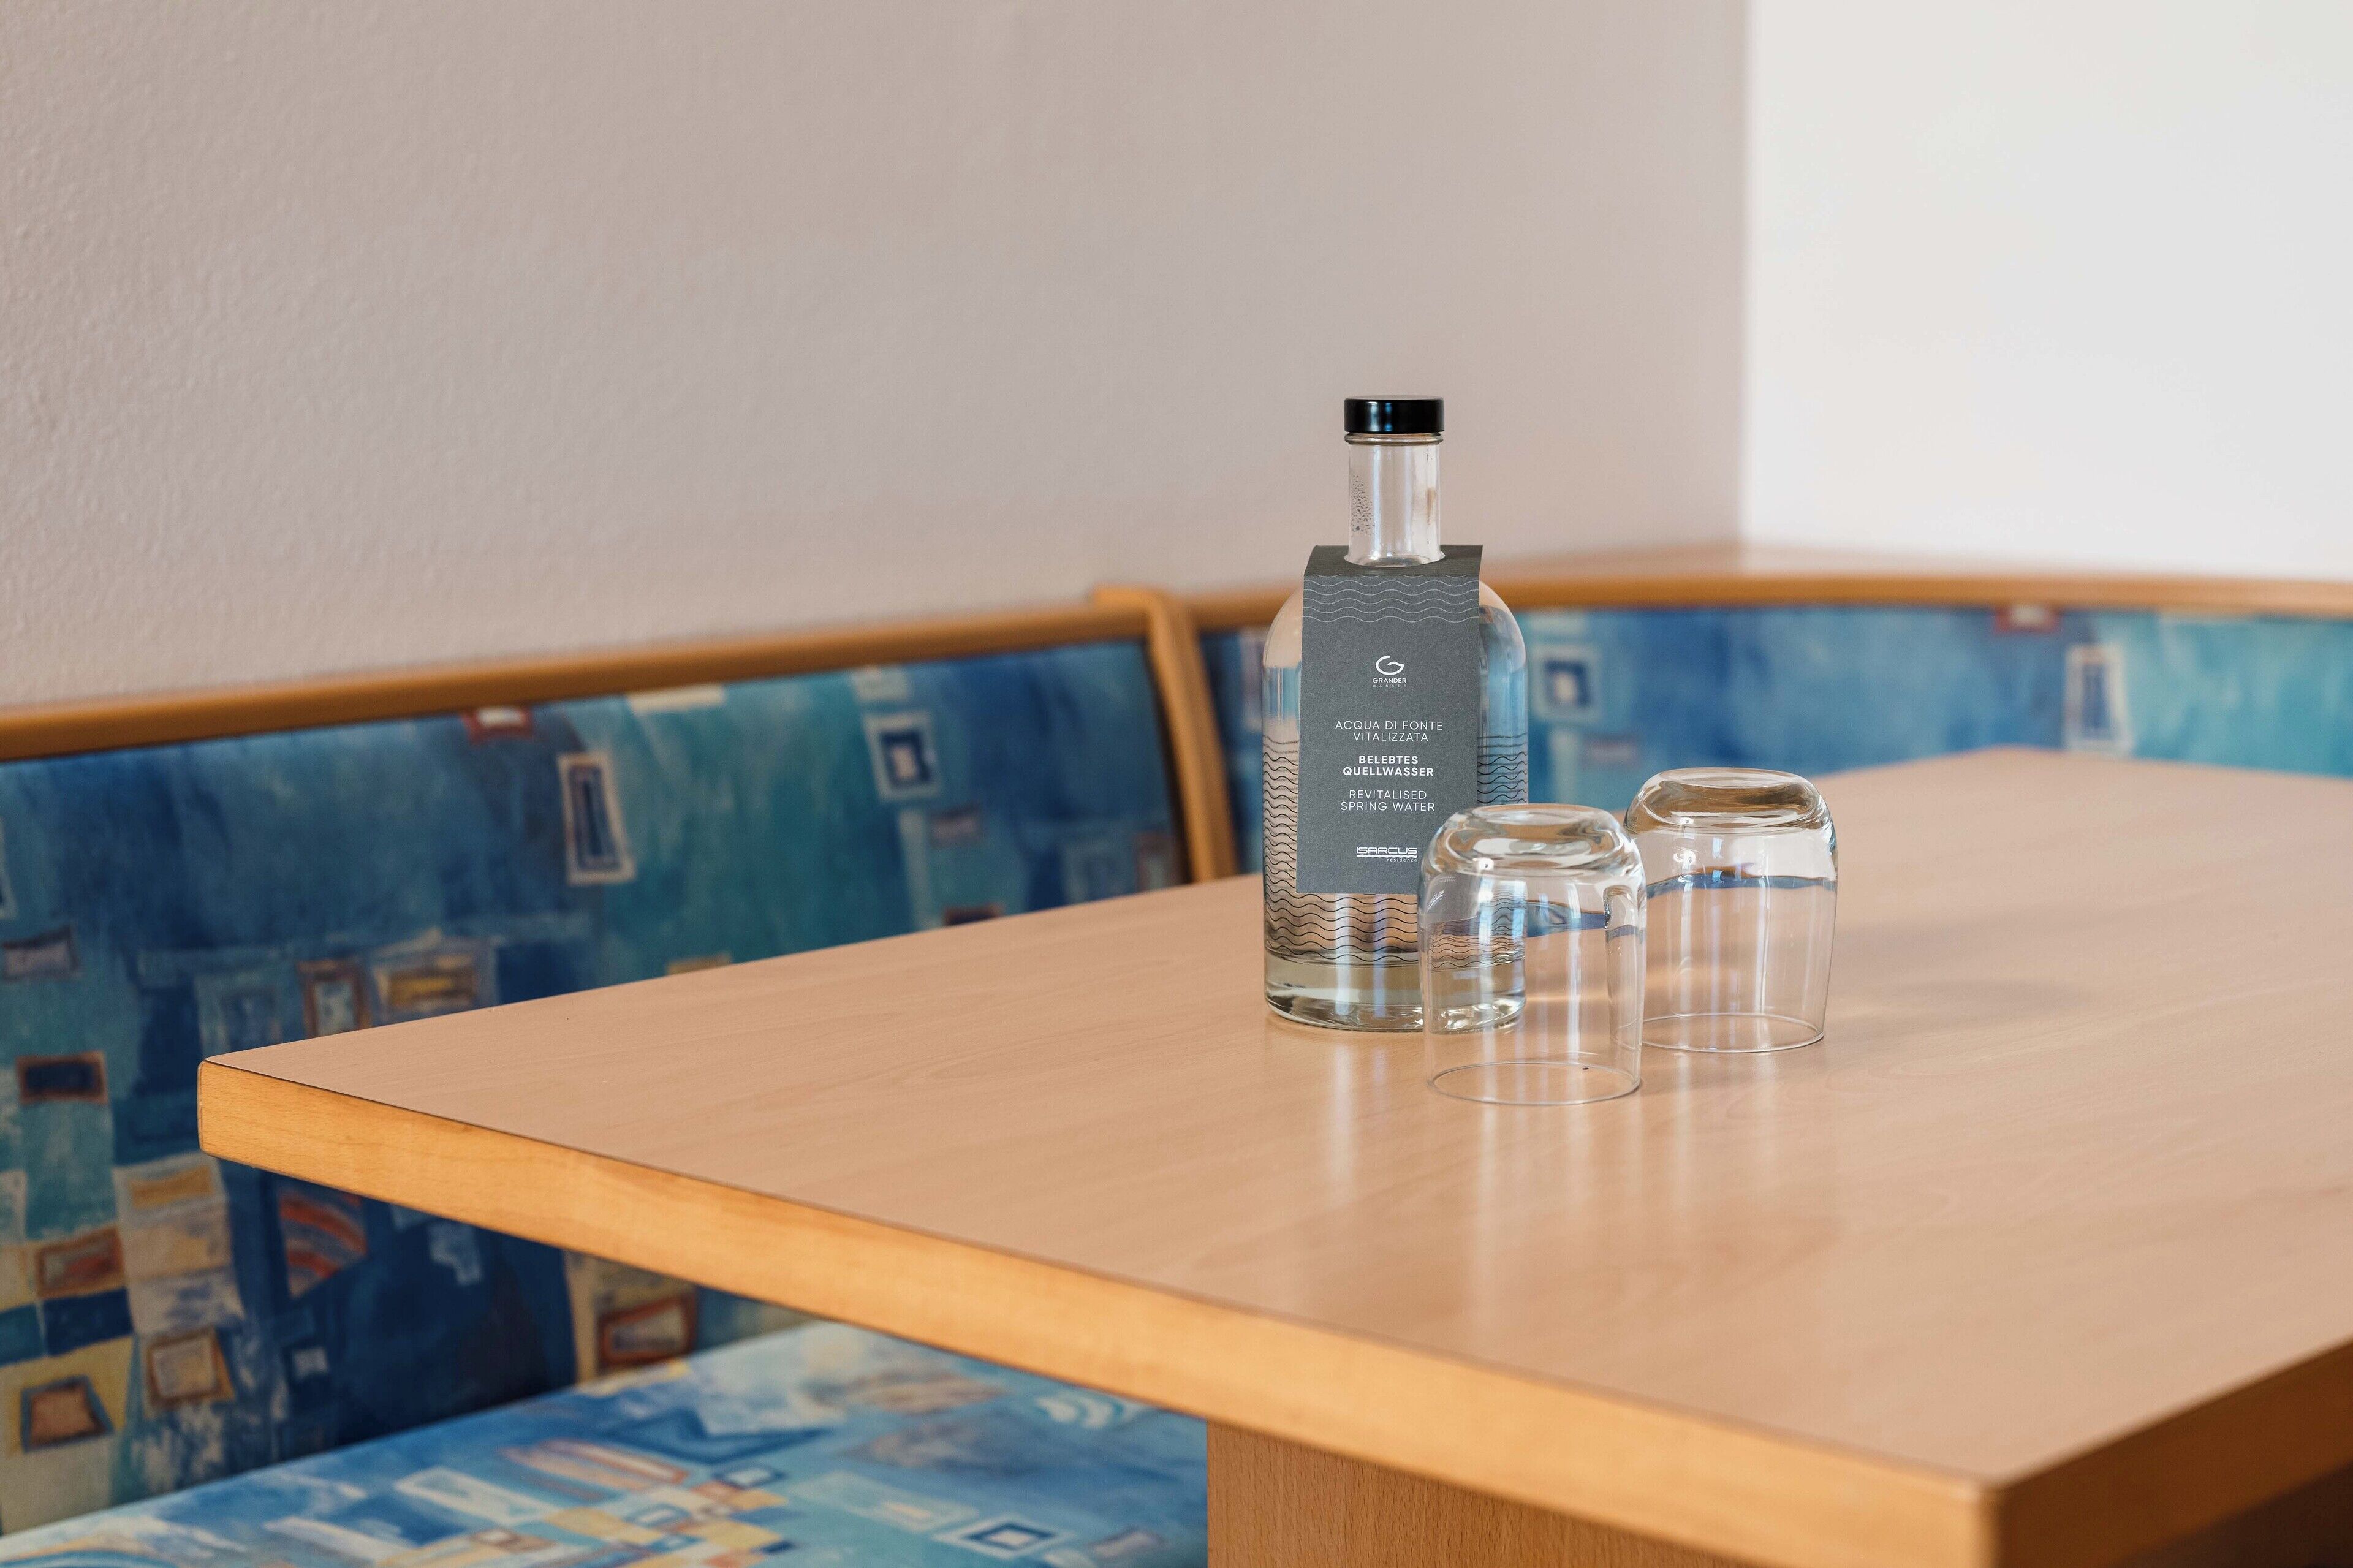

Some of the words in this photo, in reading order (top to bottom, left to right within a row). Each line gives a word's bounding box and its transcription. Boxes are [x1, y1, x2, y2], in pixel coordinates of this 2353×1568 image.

[1335, 721, 1380, 730] ACQUA
[1385, 721, 1397, 730] DI
[1403, 721, 1442, 730] FONTE
[1353, 732, 1428, 741] VITALIZZATA
[1358, 755, 1419, 765] BELEBTES
[1343, 767, 1434, 776] QUELLWASSER
[1349, 790, 1427, 800] REVITALISED
[1341, 801, 1387, 811] SPRING
[1392, 802, 1435, 811] WATER
